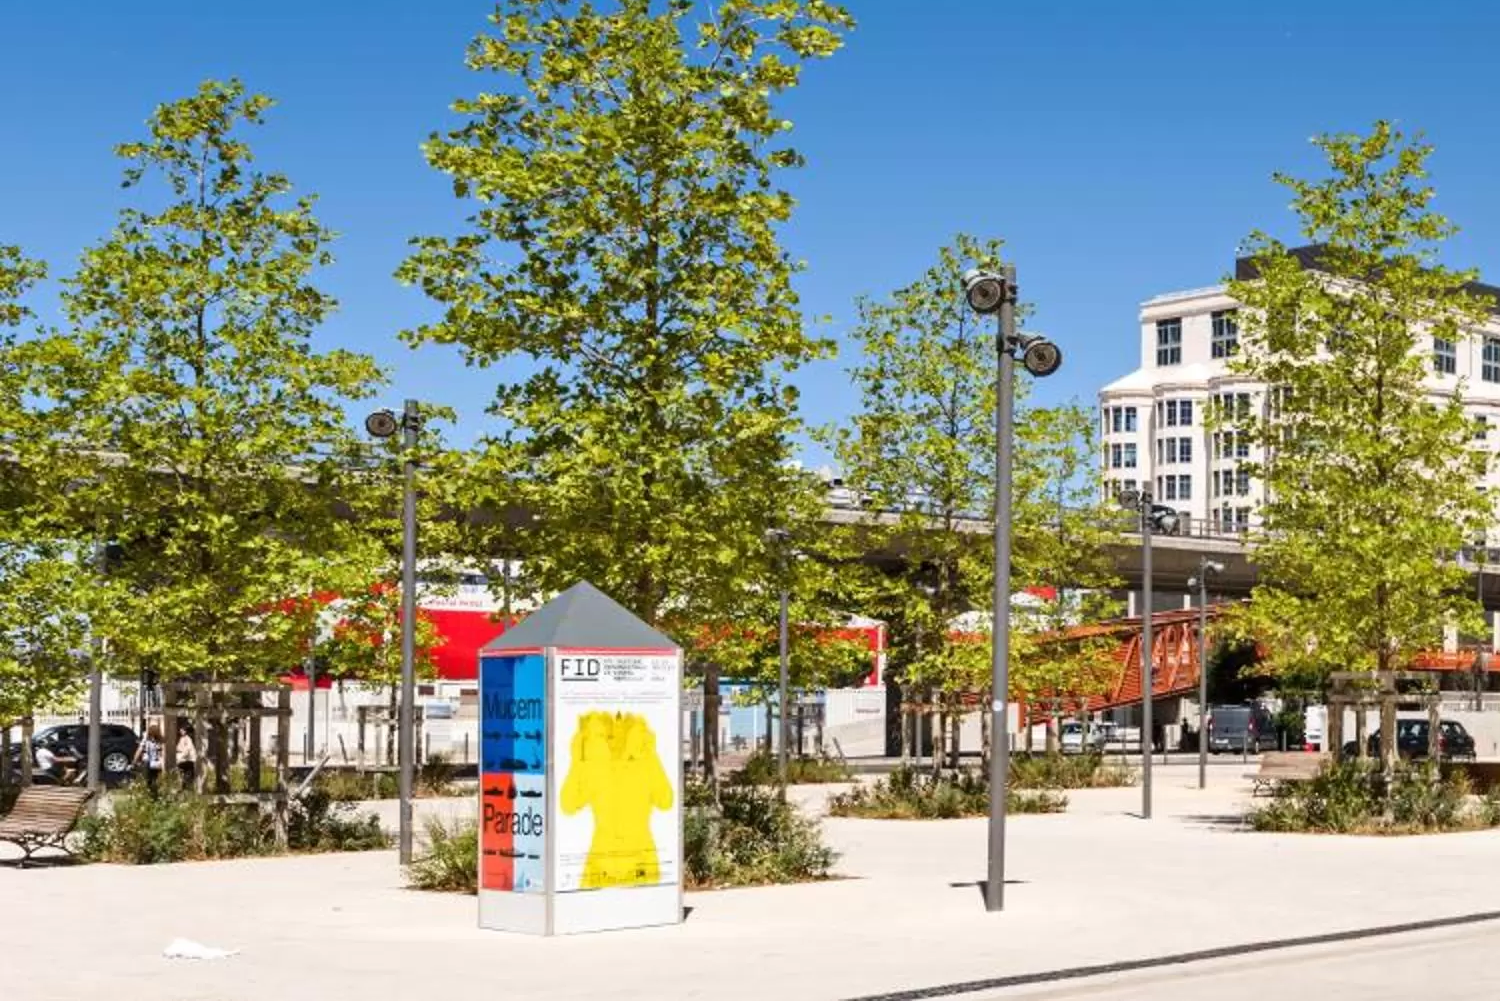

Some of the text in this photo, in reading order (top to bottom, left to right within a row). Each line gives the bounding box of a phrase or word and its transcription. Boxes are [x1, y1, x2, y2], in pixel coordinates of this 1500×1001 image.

[561, 658, 600, 676] FID
[484, 691, 542, 720] Mucem
[484, 803, 543, 837] Parade
